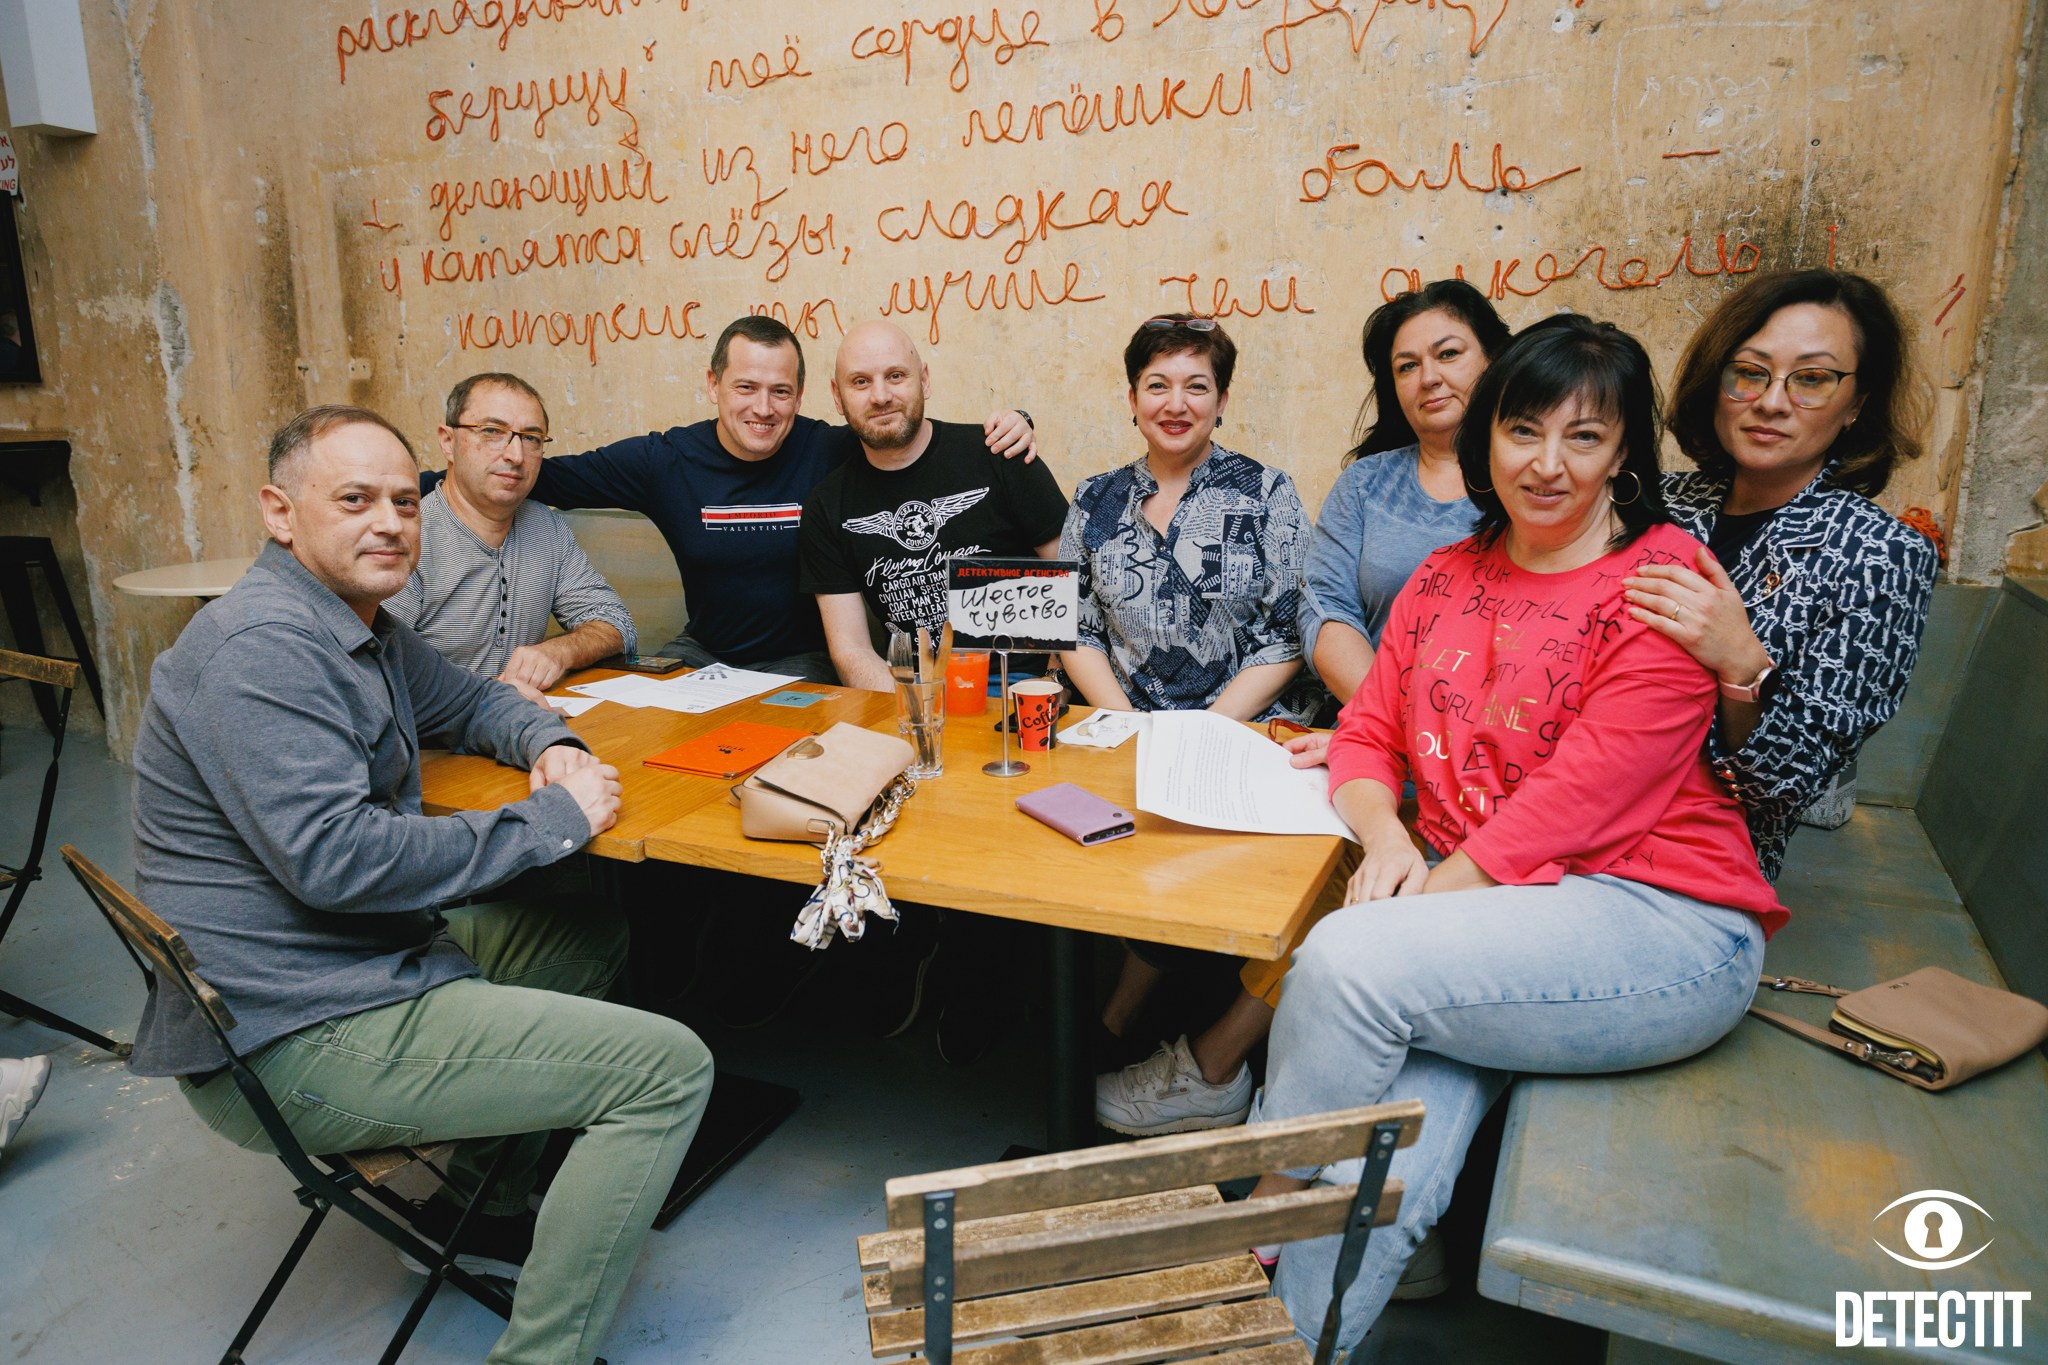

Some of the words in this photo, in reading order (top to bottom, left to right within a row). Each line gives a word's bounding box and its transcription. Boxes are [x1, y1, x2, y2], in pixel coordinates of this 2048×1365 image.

[708, 35, 812, 92] моё
[851, 8, 1050, 92] сердце
[703, 146, 788, 220] из
[791, 122, 908, 176] него
[962, 67, 1253, 147] лепёшки
[421, 225, 645, 287] катятся
[877, 180, 1190, 265] сладкая
[1299, 141, 1581, 202] боль
[459, 302, 707, 366] катарсис
[880, 262, 1106, 346] лучше
[1158, 273, 1316, 319] чем
[1380, 232, 1762, 302] акоголь
[905, 532, 933, 547] COUGAR
[864, 556, 925, 587] Flying
[882, 577, 912, 593] CARGO
[912, 575, 927, 587] AIR
[957, 567, 1021, 578] ДЕТЕКТИВНОЕ
[1023, 568, 1070, 578] АГЕНСТВО
[878, 588, 916, 604] CIVILIAN
[888, 599, 910, 613] COAT
[961, 584, 1053, 609] Шестое
[918, 608, 925, 617] &
[969, 599, 1068, 632] чувство
[1419, 638, 1471, 673] LET
[1430, 679, 1474, 724] GIRL
